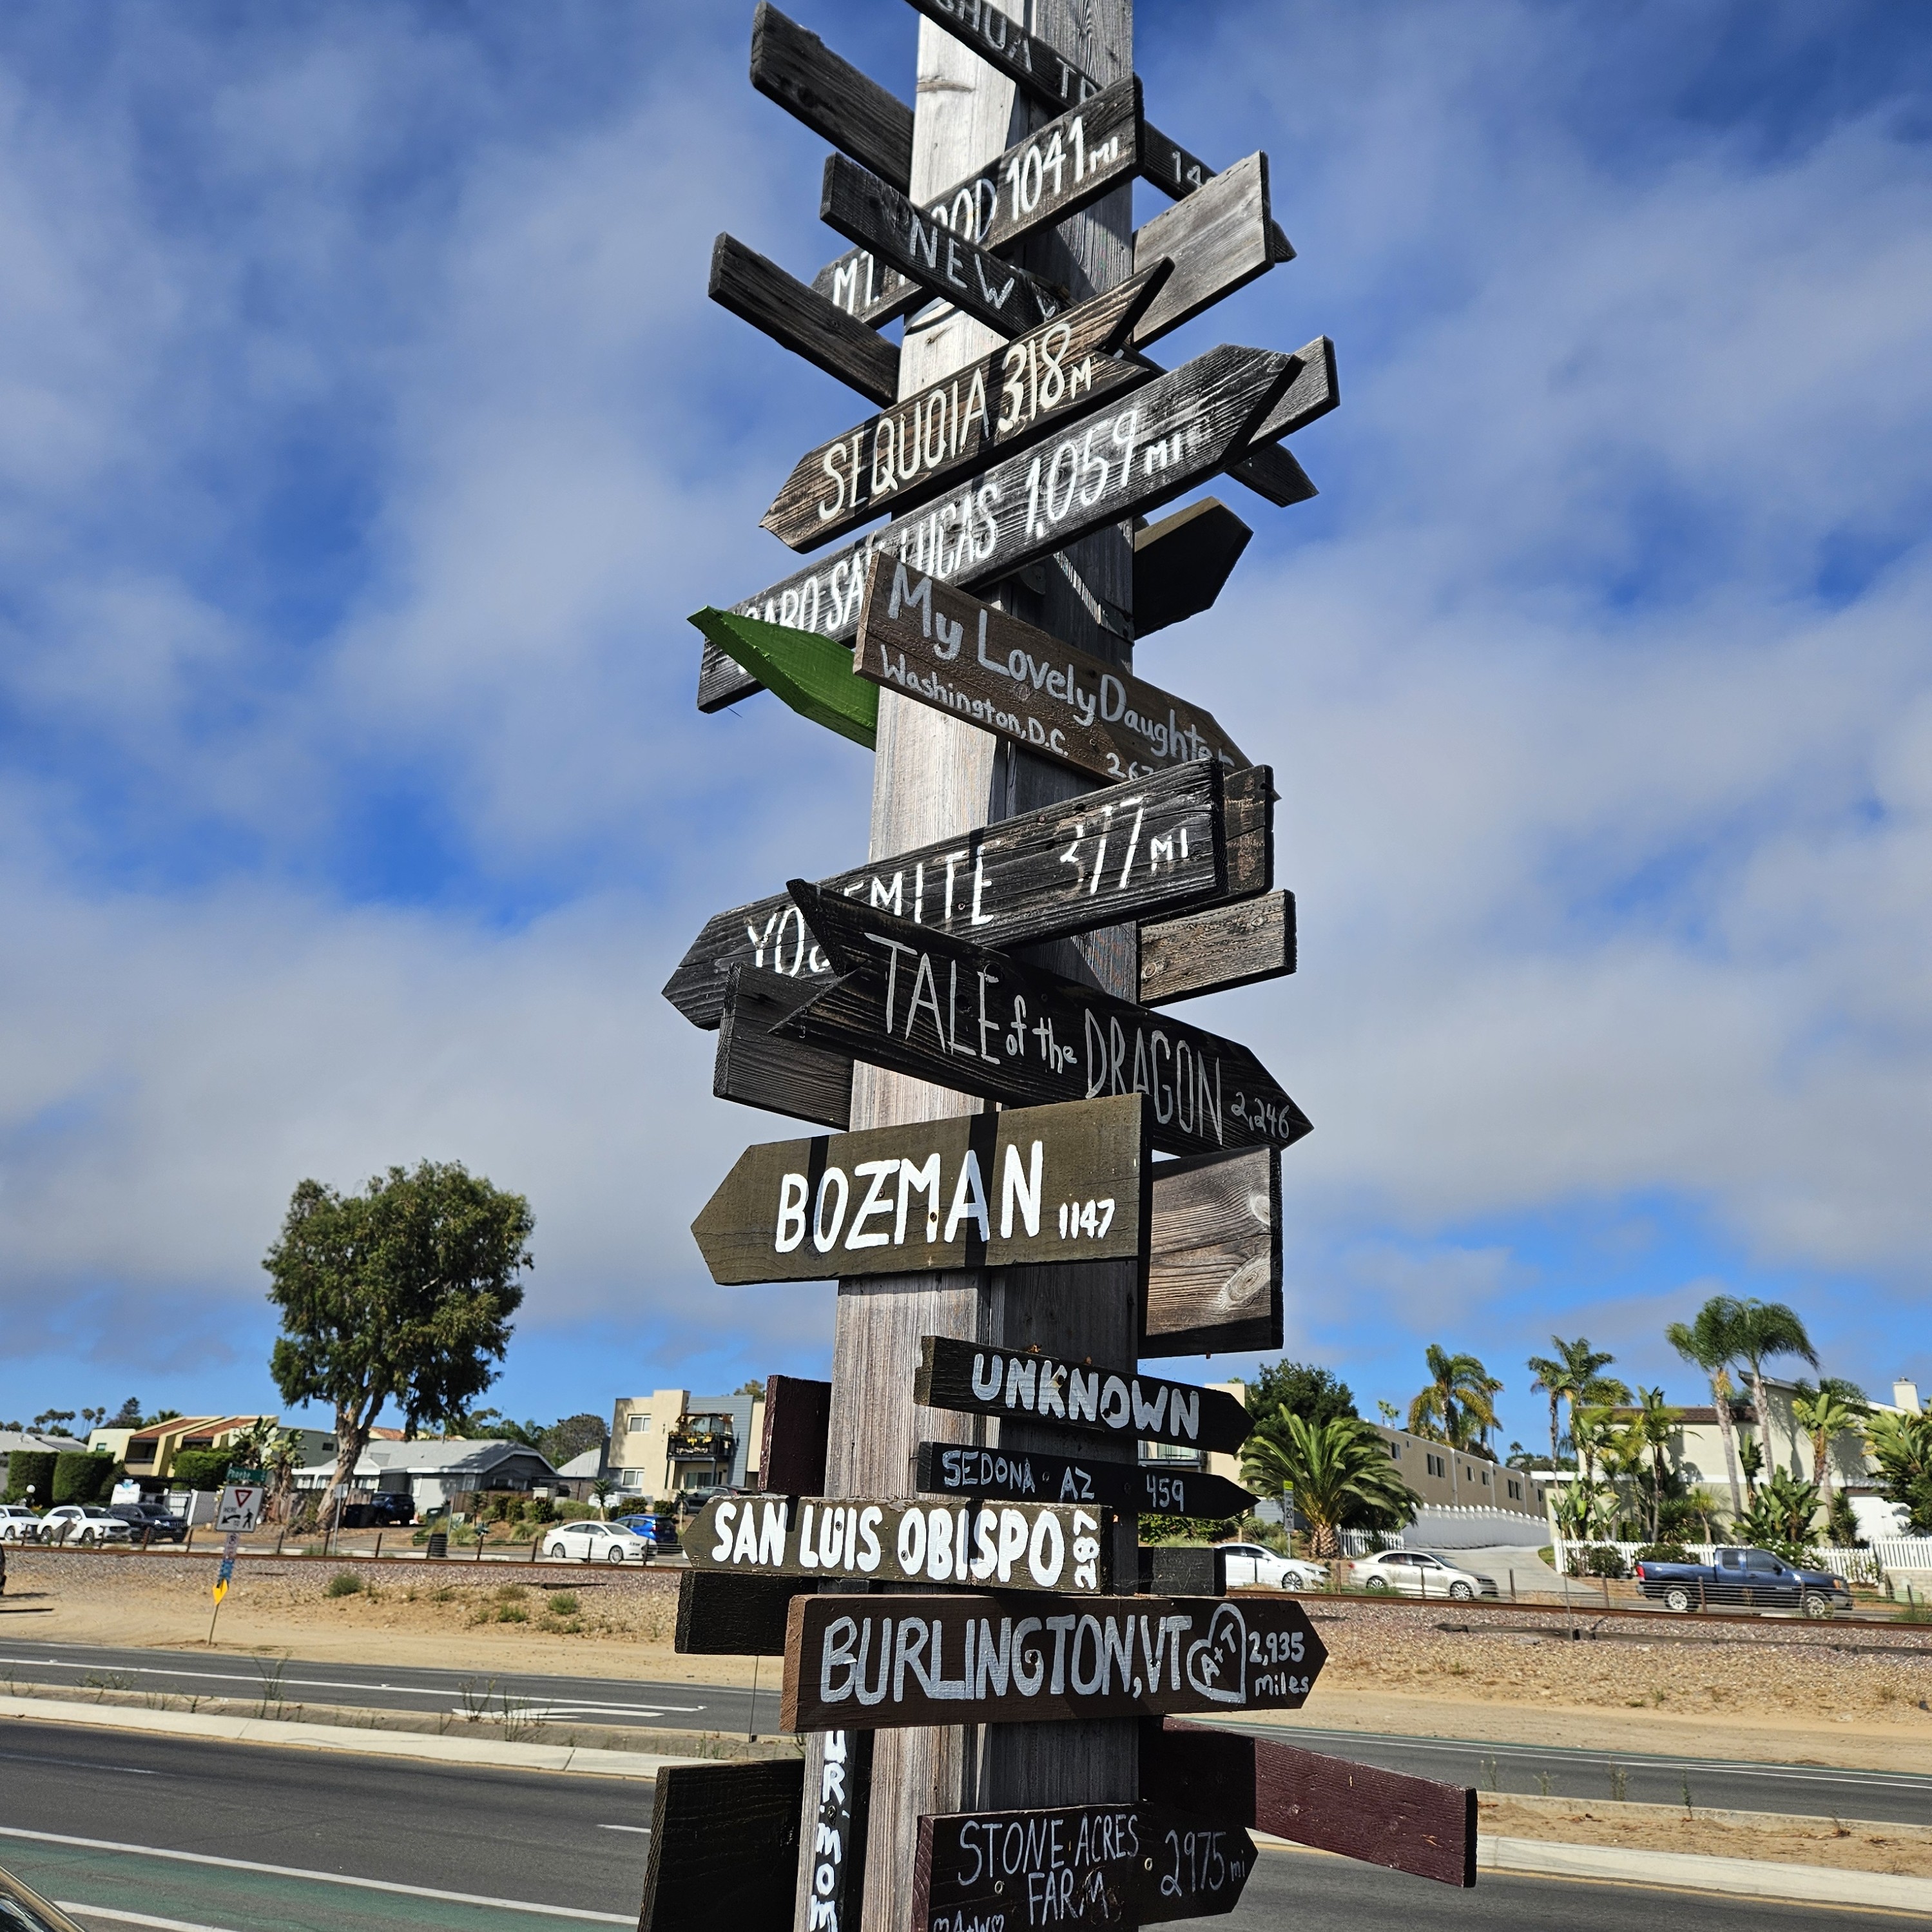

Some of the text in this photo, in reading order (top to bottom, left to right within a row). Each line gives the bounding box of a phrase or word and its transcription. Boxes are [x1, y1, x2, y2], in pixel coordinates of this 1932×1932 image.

[936, 0, 1032, 72] HUA
[1005, 116, 1085, 221] 1041
[909, 214, 1015, 310] NEW
[818, 367, 991, 521] SEQUOIA
[997, 322, 1072, 433] 318
[887, 561, 964, 661] My
[977, 608, 1096, 727] Lovely
[1106, 752, 1155, 782] 26
[746, 842, 996, 978] YOMITE
[864, 932, 1000, 1065] TALE
[1005, 994, 1027, 1056] of
[1032, 1016, 1077, 1074] the
[1085, 1008, 1223, 1146] DRAGON
[775, 1139, 1116, 1253] BOZMAN 1147
[972, 1353, 1200, 1440] UNKNOWN
[942, 1449, 1184, 1512] SEDONA AZ 459
[711, 1501, 1065, 1587] SAN LUIS OBISPO
[1248, 1630, 1306, 1666] 2,935
[1255, 1670, 1309, 1697] miles
[958, 1812, 1139, 1886] STONE ACRES
[1161, 1829, 1246, 1897] 2975 mi
[1028, 1868, 1109, 1926] FARM
